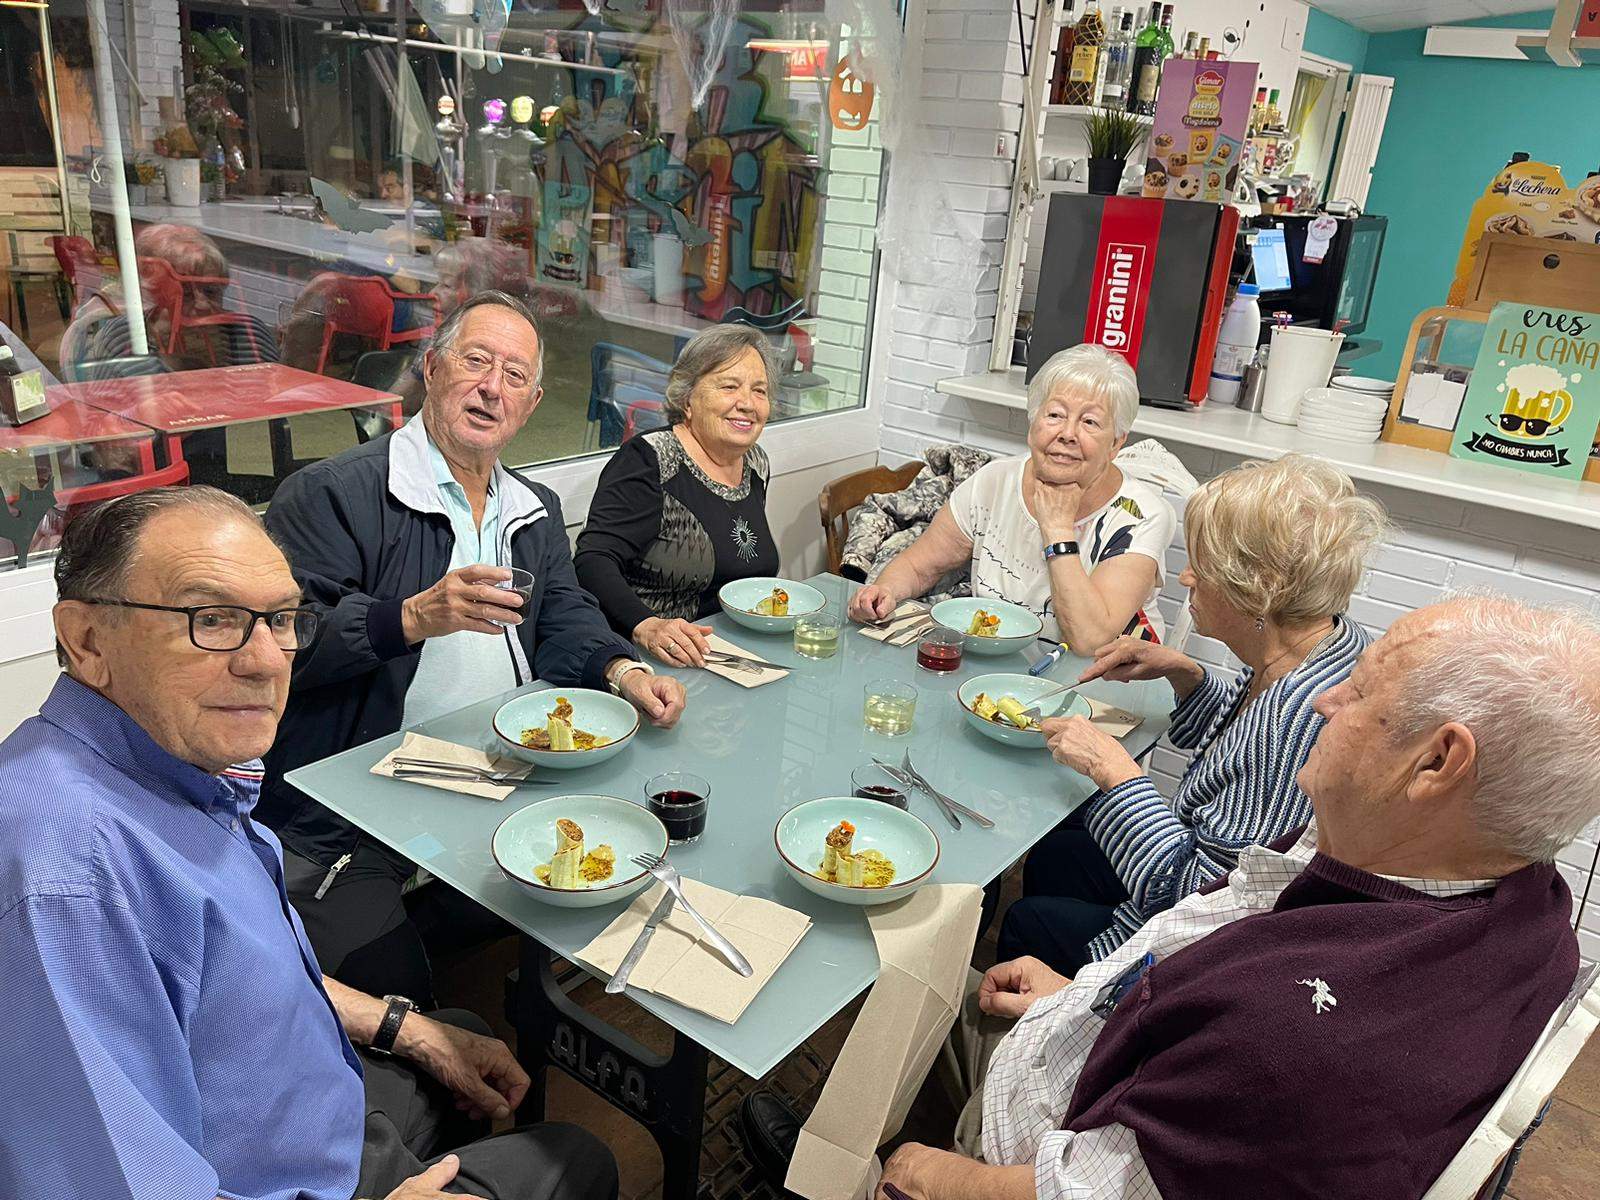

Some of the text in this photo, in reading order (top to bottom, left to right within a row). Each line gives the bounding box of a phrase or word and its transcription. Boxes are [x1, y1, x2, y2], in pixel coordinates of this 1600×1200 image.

[1512, 178, 1561, 197] Lechera
[1102, 251, 1134, 347] granini
[1523, 309, 1591, 336] eres
[1497, 328, 1600, 370] LA CAÑA
[1495, 443, 1525, 458] CAMBIES
[1526, 449, 1553, 459] NUNCA
[552, 1022, 648, 1113] ALFA
